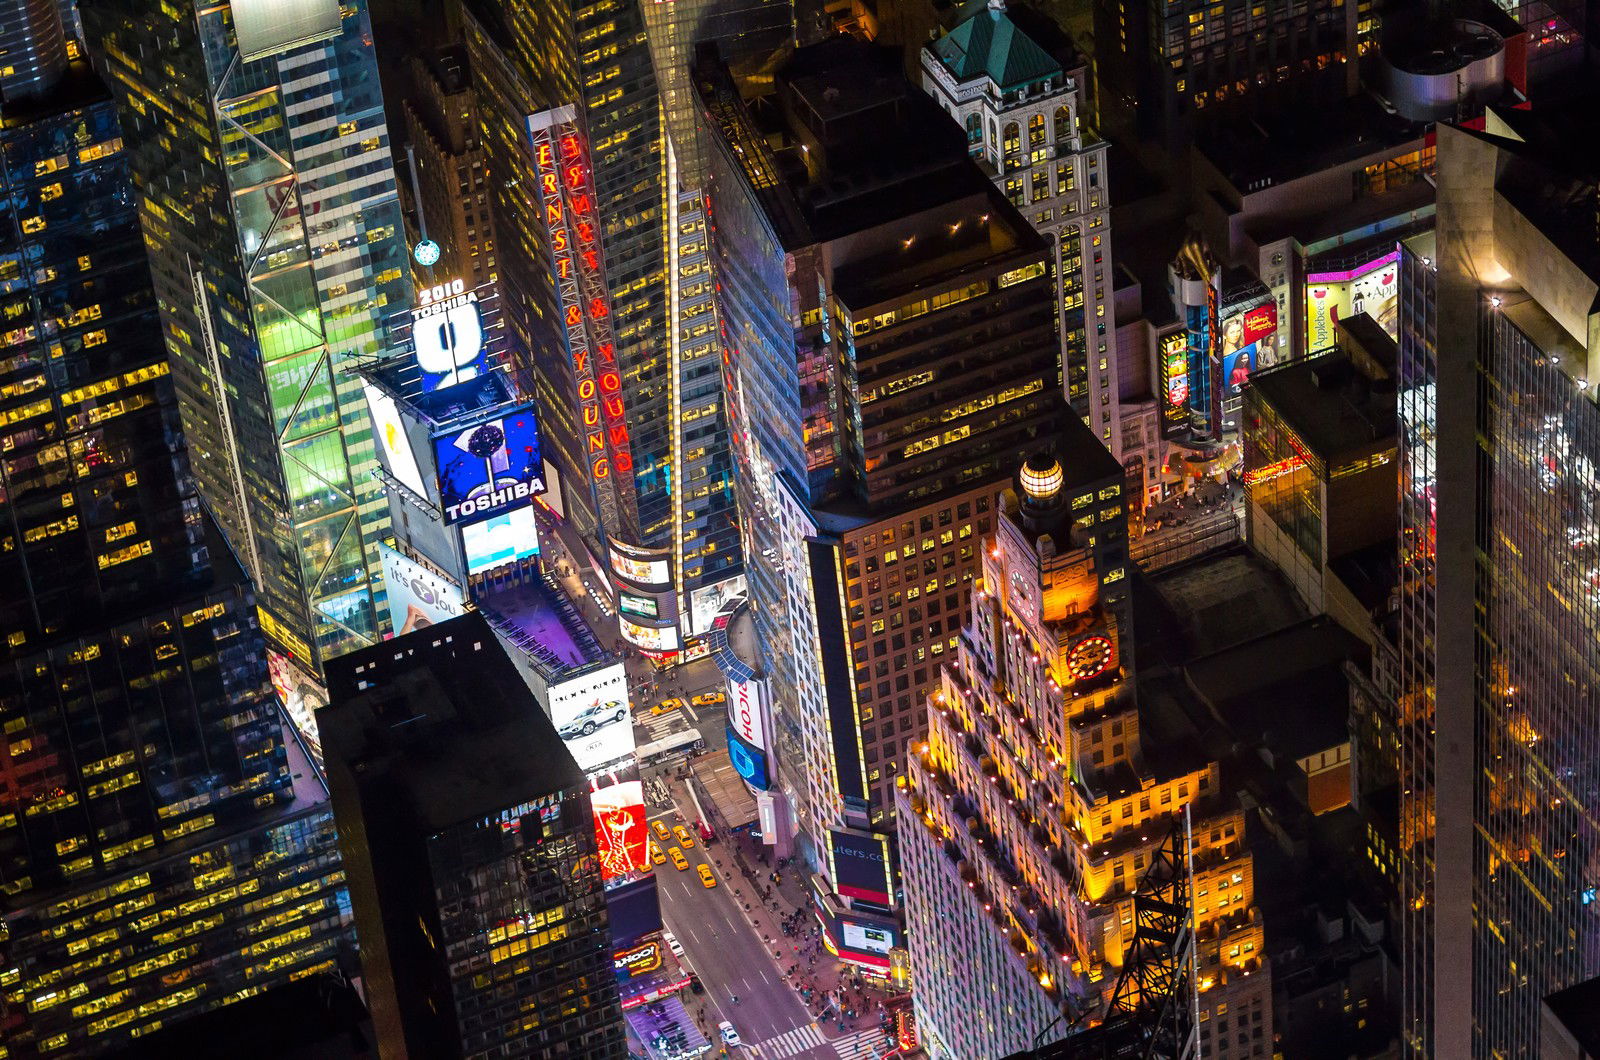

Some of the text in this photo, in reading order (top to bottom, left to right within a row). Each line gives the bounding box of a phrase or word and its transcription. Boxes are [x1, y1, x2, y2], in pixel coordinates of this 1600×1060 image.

[411, 291, 478, 321] TOSHIBA
[419, 279, 464, 306] 2010
[539, 143, 610, 478] ERNST & YOUNG
[445, 477, 545, 521] TOSHIBA
[737, 682, 753, 741] RICOH
